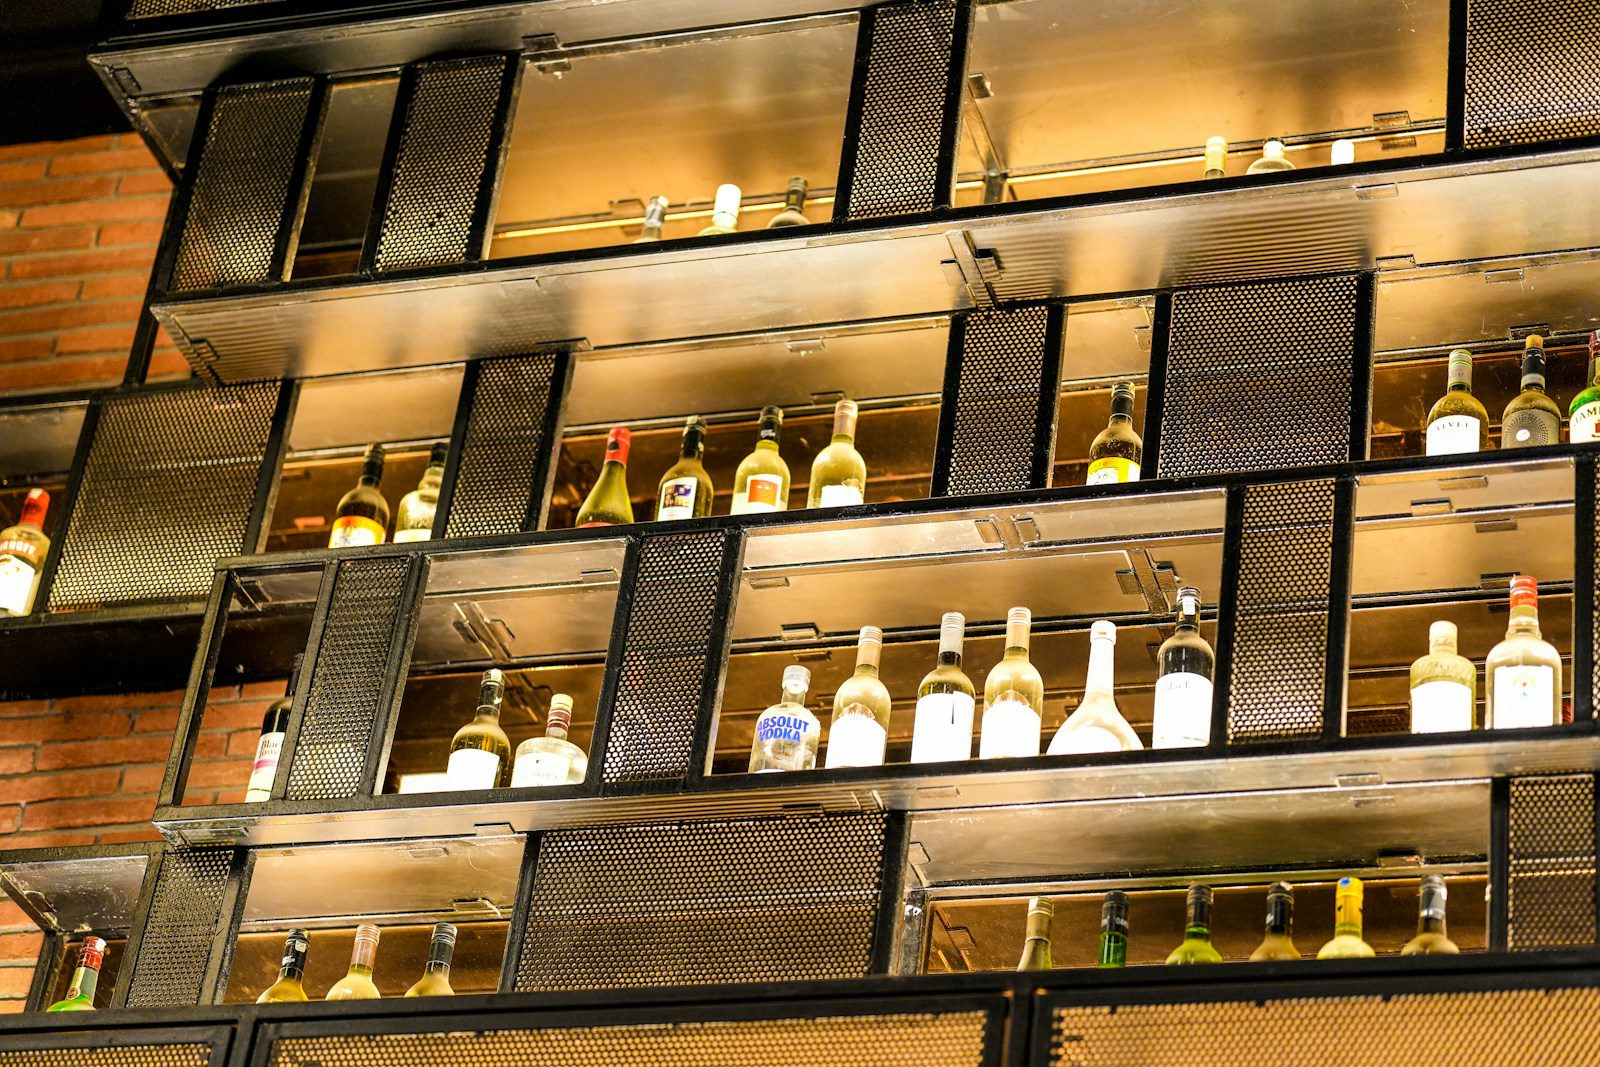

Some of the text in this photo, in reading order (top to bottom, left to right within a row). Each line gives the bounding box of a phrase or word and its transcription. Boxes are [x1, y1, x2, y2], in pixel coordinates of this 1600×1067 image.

[1574, 406, 1600, 426] JAM
[757, 715, 809, 733] ABSOLUT
[759, 727, 801, 743] VODKA
